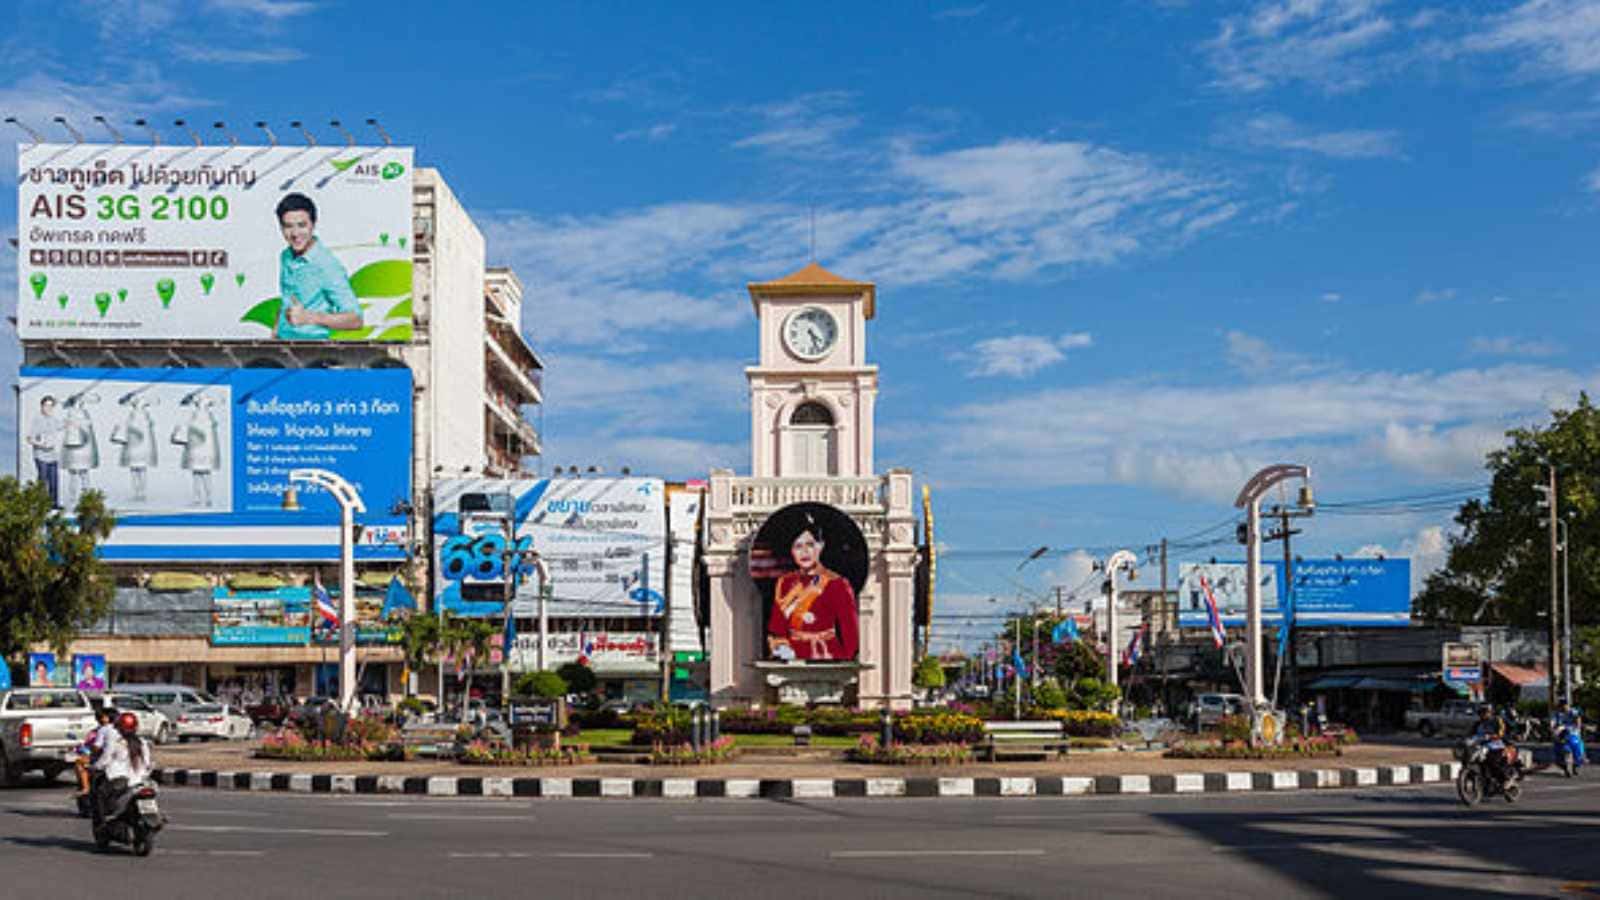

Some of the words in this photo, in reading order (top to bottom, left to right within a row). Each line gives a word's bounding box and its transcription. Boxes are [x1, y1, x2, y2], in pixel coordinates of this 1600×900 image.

[355, 165, 379, 176] AIS
[30, 194, 87, 219] AIS
[97, 194, 141, 220] 3G
[151, 194, 229, 220] 2100
